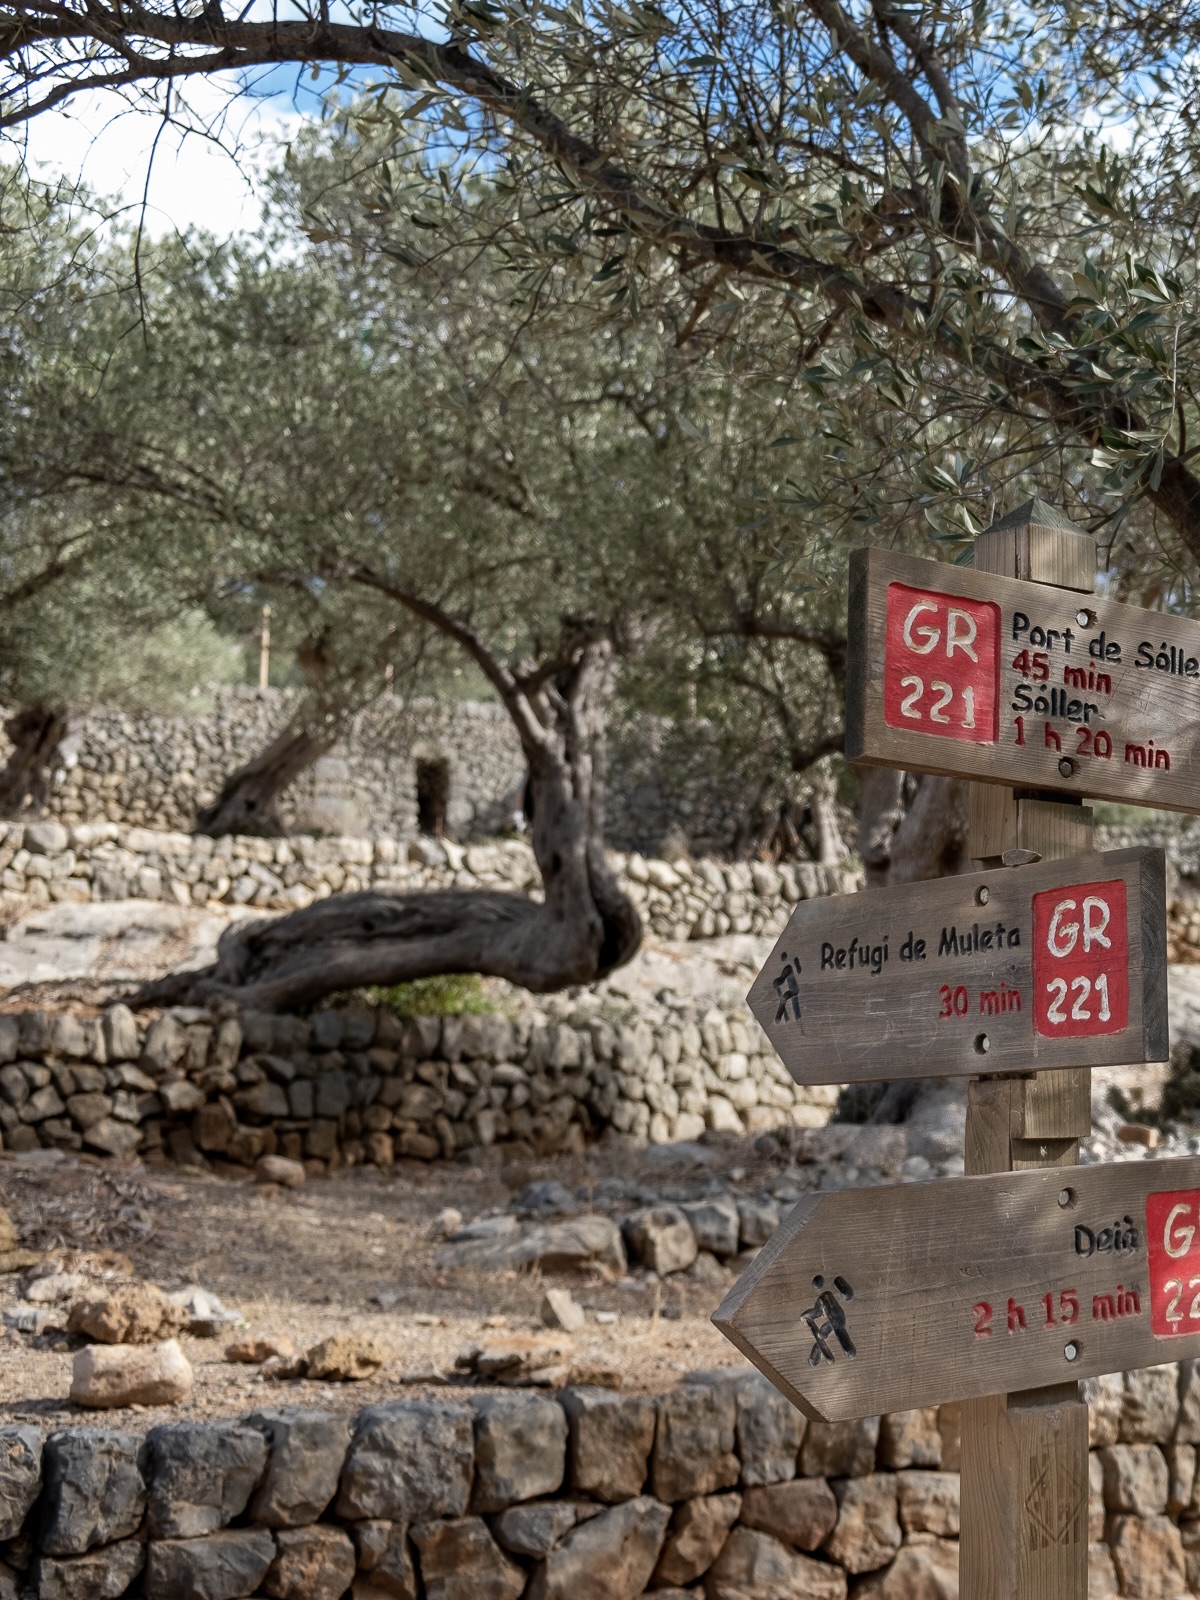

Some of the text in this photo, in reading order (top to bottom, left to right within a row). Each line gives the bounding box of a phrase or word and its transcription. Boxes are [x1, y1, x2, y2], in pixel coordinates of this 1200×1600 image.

[903, 599, 979, 663] GR
[1012, 612, 1075, 654] Port
[1088, 631, 1122, 664] de
[1012, 649, 1112, 696] 45 min
[900, 675, 976, 729] 221
[1011, 684, 1100, 724] Sóller
[1014, 716, 1170, 772] 1 h 20 min
[820, 923, 1021, 977] Refugi de Muleta
[1047, 895, 1111, 958] GR
[938, 982, 1022, 1020] 30 min
[1046, 972, 1110, 1025] 221
[1074, 1215, 1140, 1258] Deià
[972, 1284, 1142, 1339] 2 h 15 min
